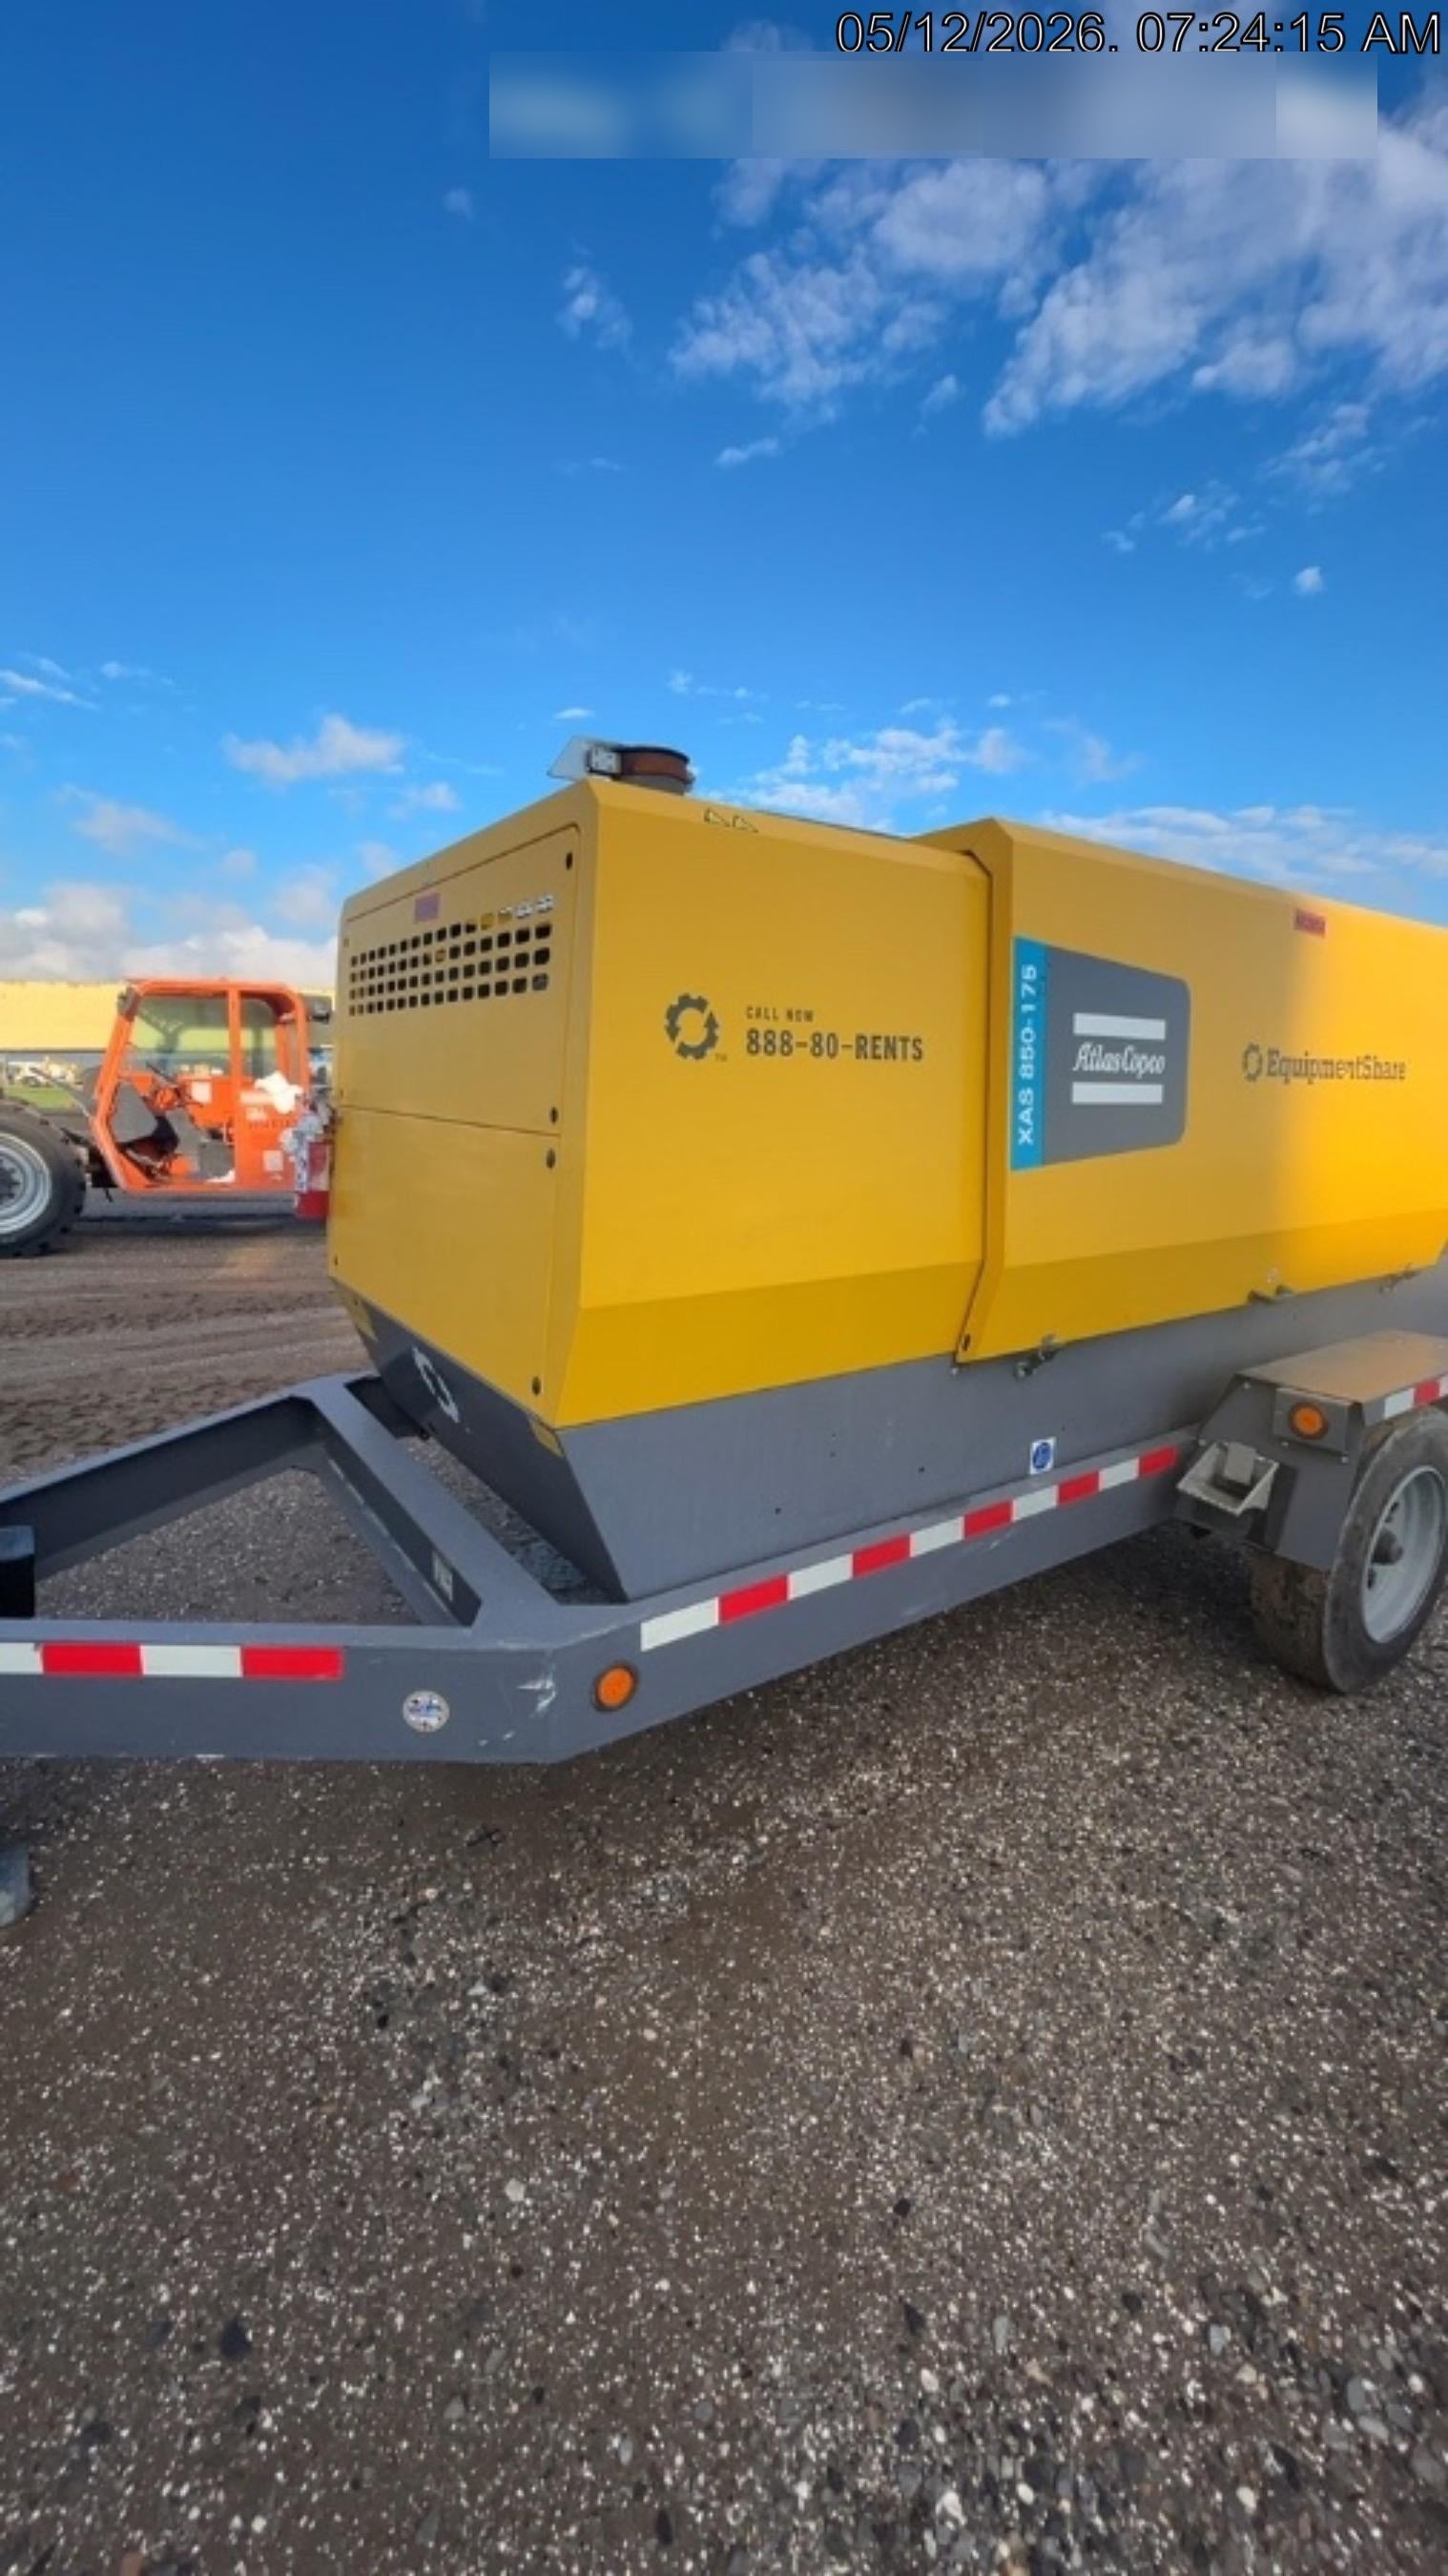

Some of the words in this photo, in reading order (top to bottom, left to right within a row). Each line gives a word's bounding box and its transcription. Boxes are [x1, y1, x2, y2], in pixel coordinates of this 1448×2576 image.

[747, 1007, 778, 1021] CALL
[787, 1009, 815, 1023] NOW
[1018, 964, 1038, 1079] 850-175
[747, 1028, 924, 1061] 888-80-RENTS
[1267, 1049, 1406, 1085] EquipmentShare
[1018, 1088, 1035, 1145] XAS
